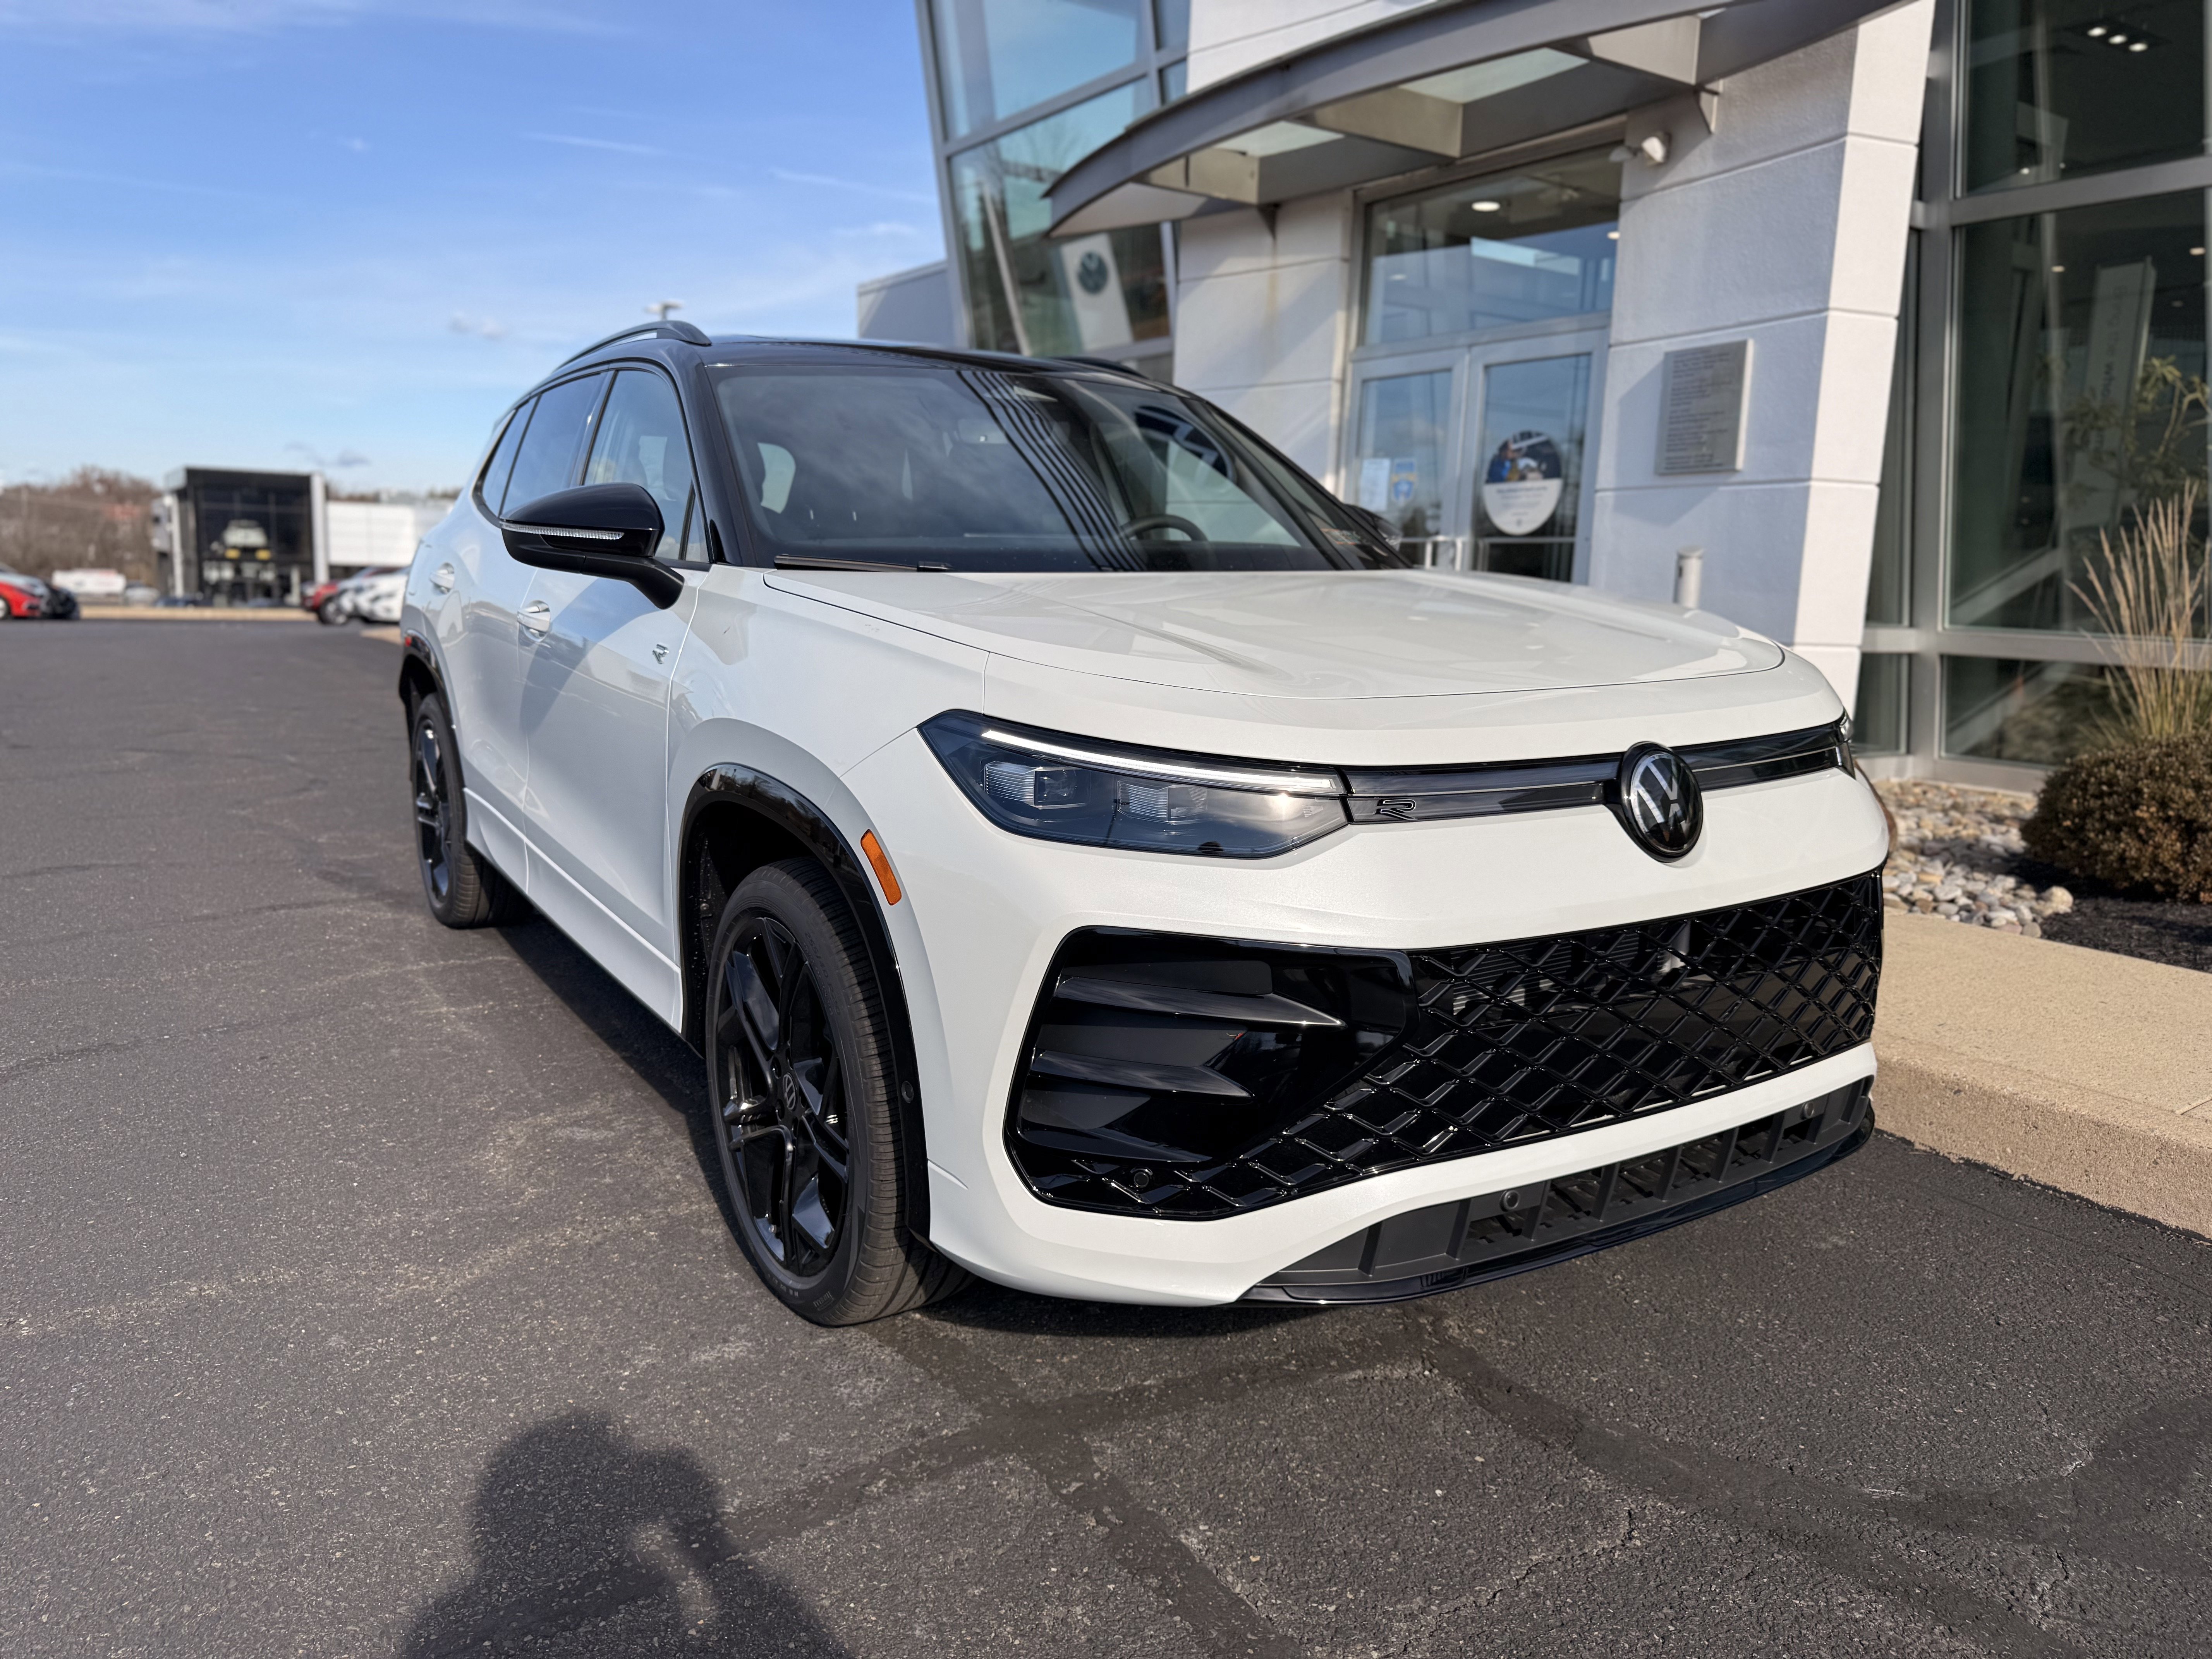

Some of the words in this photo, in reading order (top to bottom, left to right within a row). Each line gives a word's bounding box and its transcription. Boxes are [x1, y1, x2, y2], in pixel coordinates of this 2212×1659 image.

[1377, 799, 1418, 820] R
[1630, 753, 1694, 853] VW
[782, 1073, 796, 1110] VW
